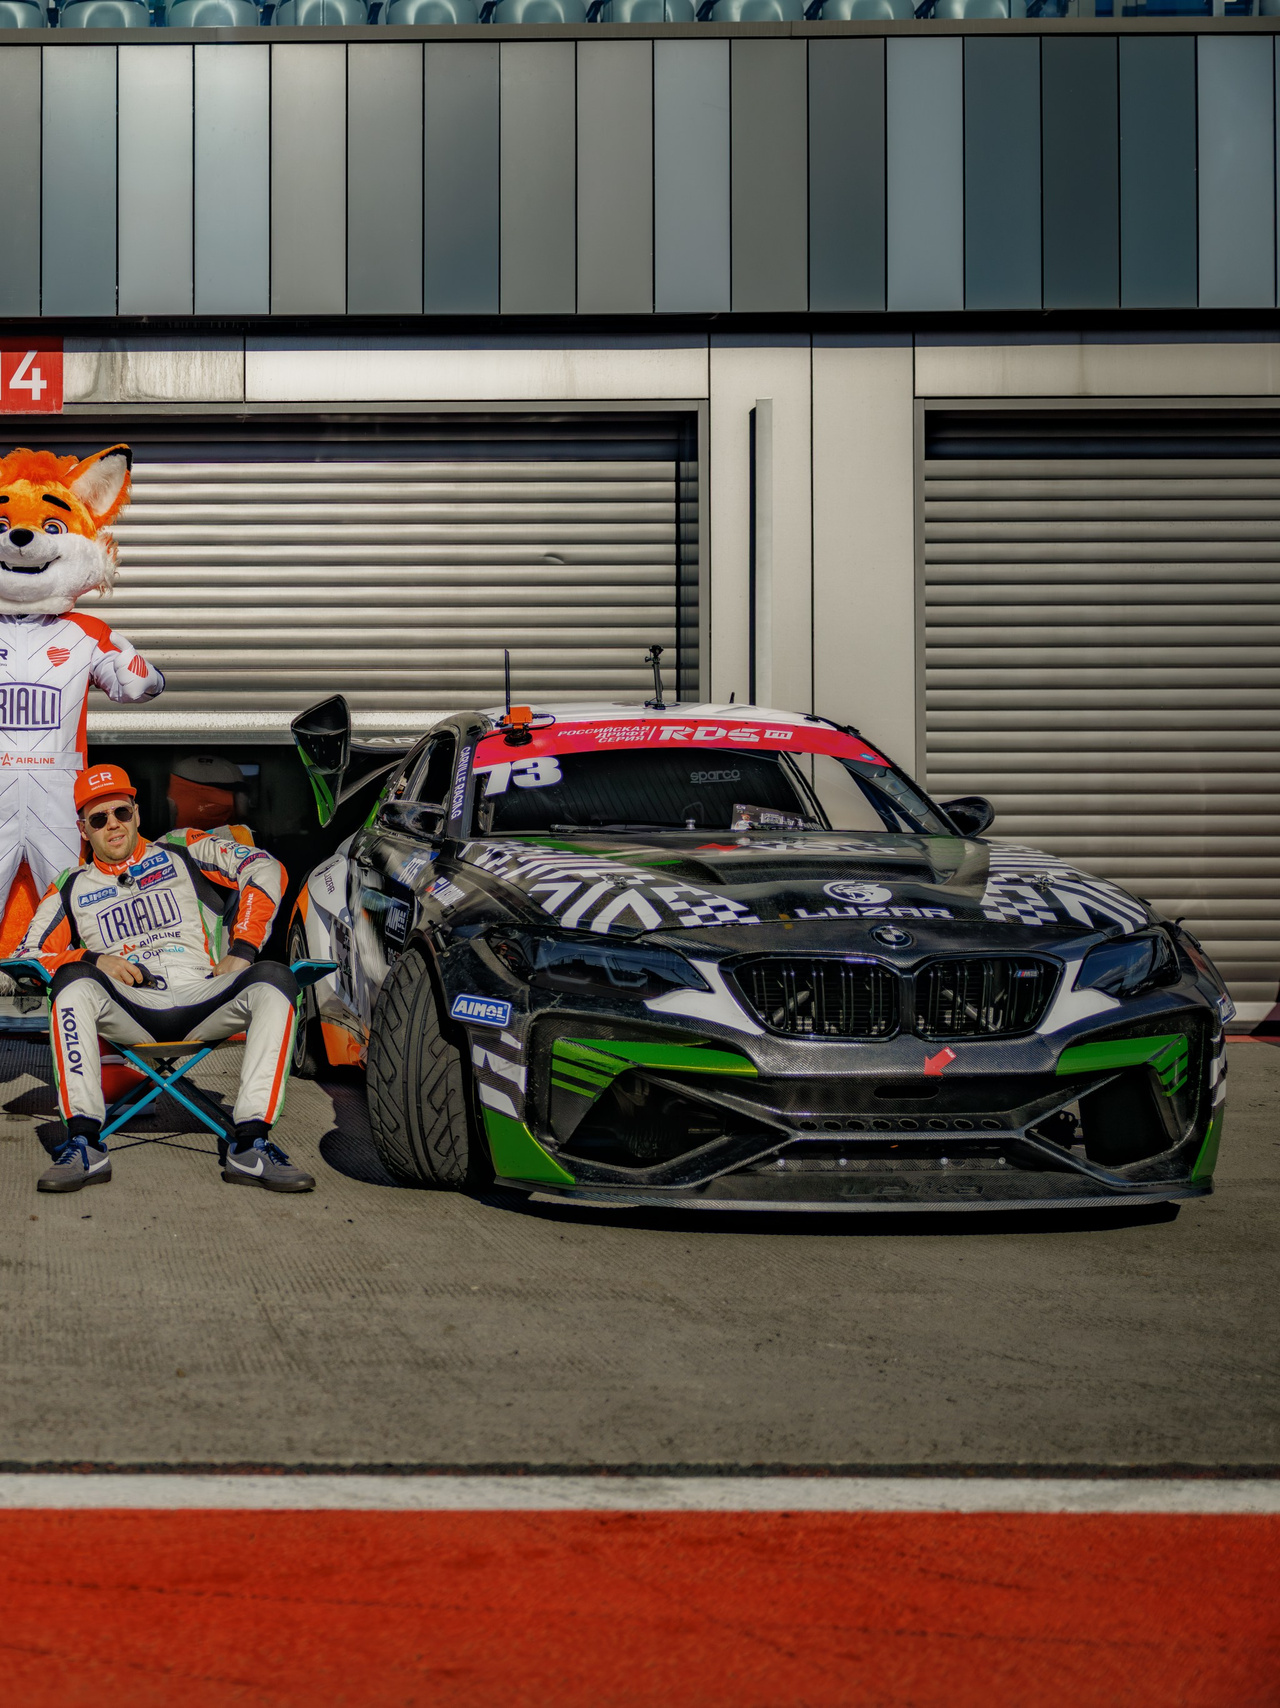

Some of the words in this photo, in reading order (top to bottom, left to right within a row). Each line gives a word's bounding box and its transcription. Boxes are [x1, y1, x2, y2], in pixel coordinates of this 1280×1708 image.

[558, 726, 650, 736] РОССИЙСКАЯ
[595, 731, 648, 739] ДРИФТ
[659, 726, 761, 742] RDS
[15, 756, 55, 764] AIRLINE
[88, 771, 113, 786] CR
[474, 757, 562, 796] 73
[690, 769, 740, 784] sparco
[141, 855, 164, 869] ВТБ
[140, 870, 163, 887] RDS
[162, 866, 173, 876] GP
[80, 888, 116, 905] AIMOL
[244, 893, 254, 924] AIRLINE
[794, 906, 954, 919] LUZAR
[101, 893, 176, 943] TRIALLI
[139, 931, 181, 948] AIRLINE
[455, 999, 507, 1022] AIMOL
[60, 1007, 84, 1077] KOZLOV
